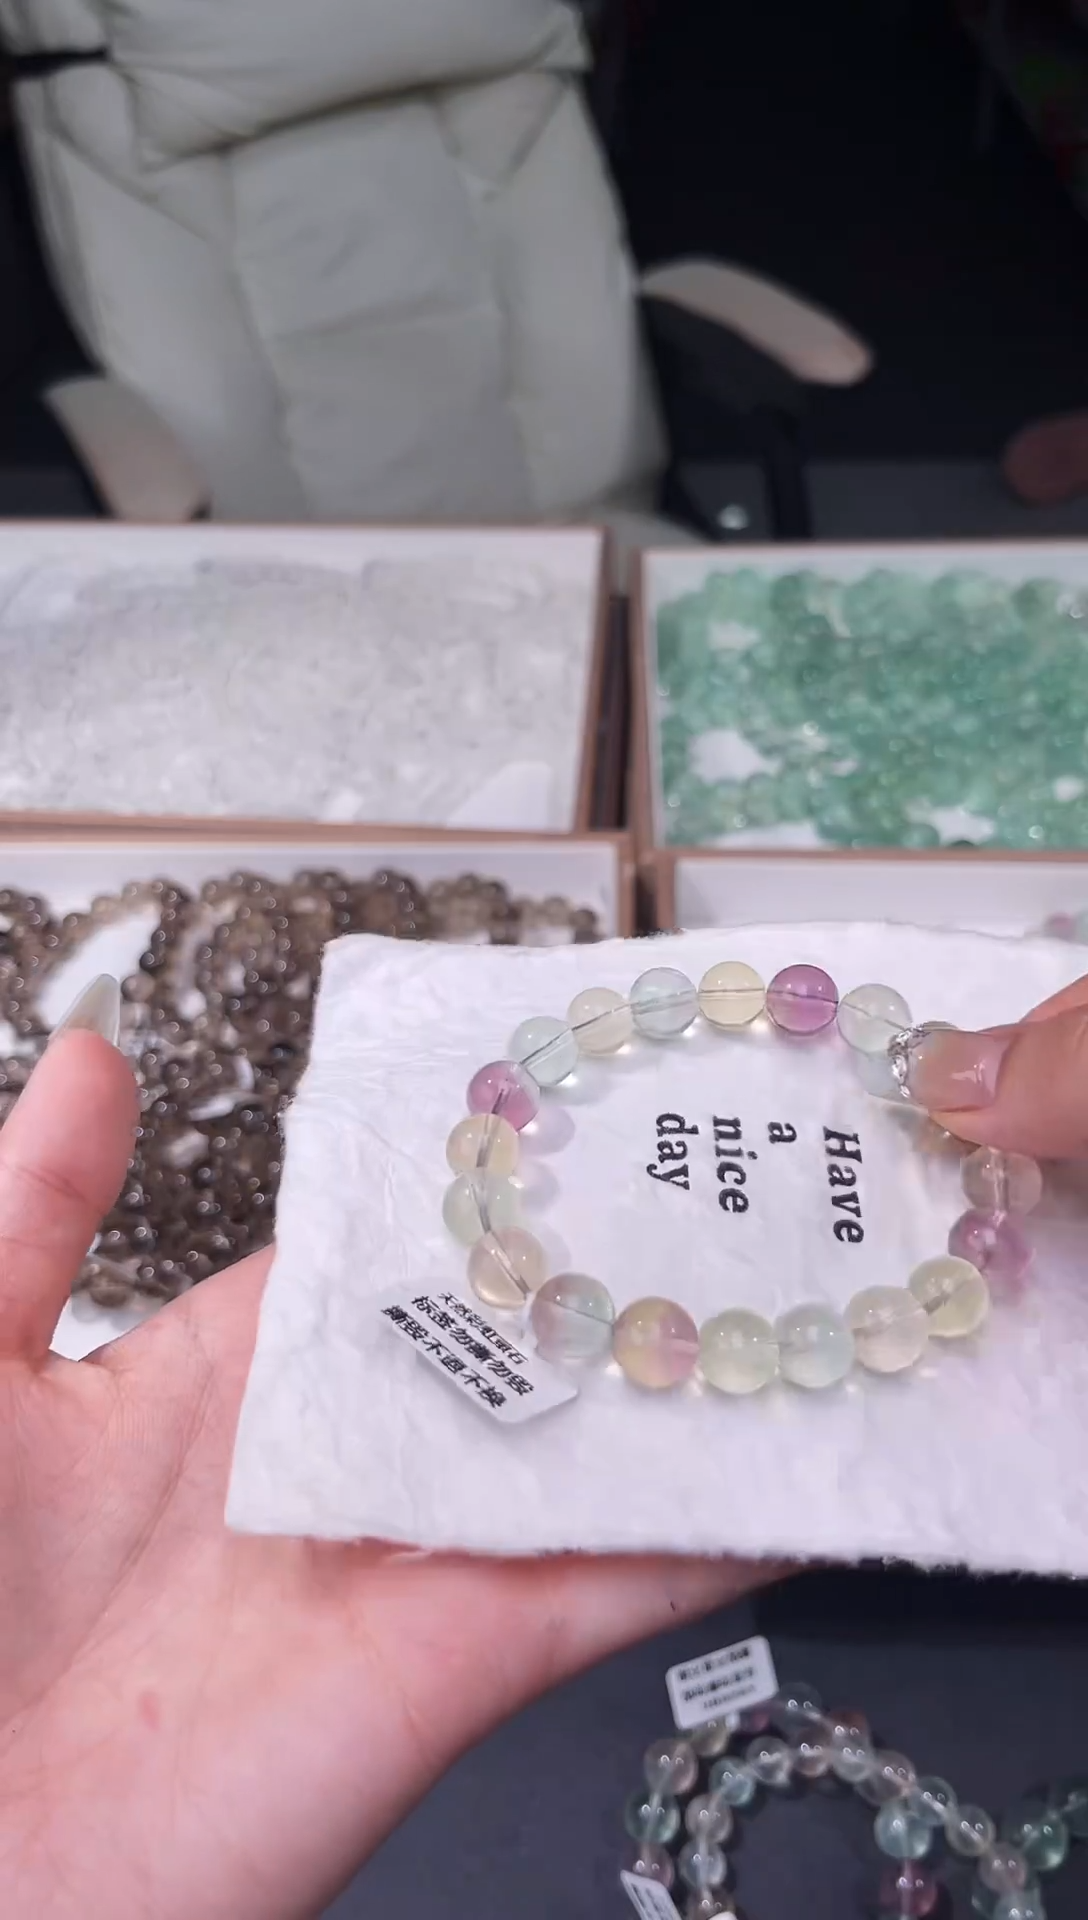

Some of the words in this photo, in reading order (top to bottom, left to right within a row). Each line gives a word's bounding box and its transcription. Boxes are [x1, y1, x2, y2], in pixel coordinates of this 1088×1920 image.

[646, 1112, 700, 1191] day
[712, 1115, 758, 1213] nice
[767, 1121, 798, 1144] a
[822, 1125, 865, 1243] Have
[411, 1296, 534, 1396] 标签勿撕勿毁
